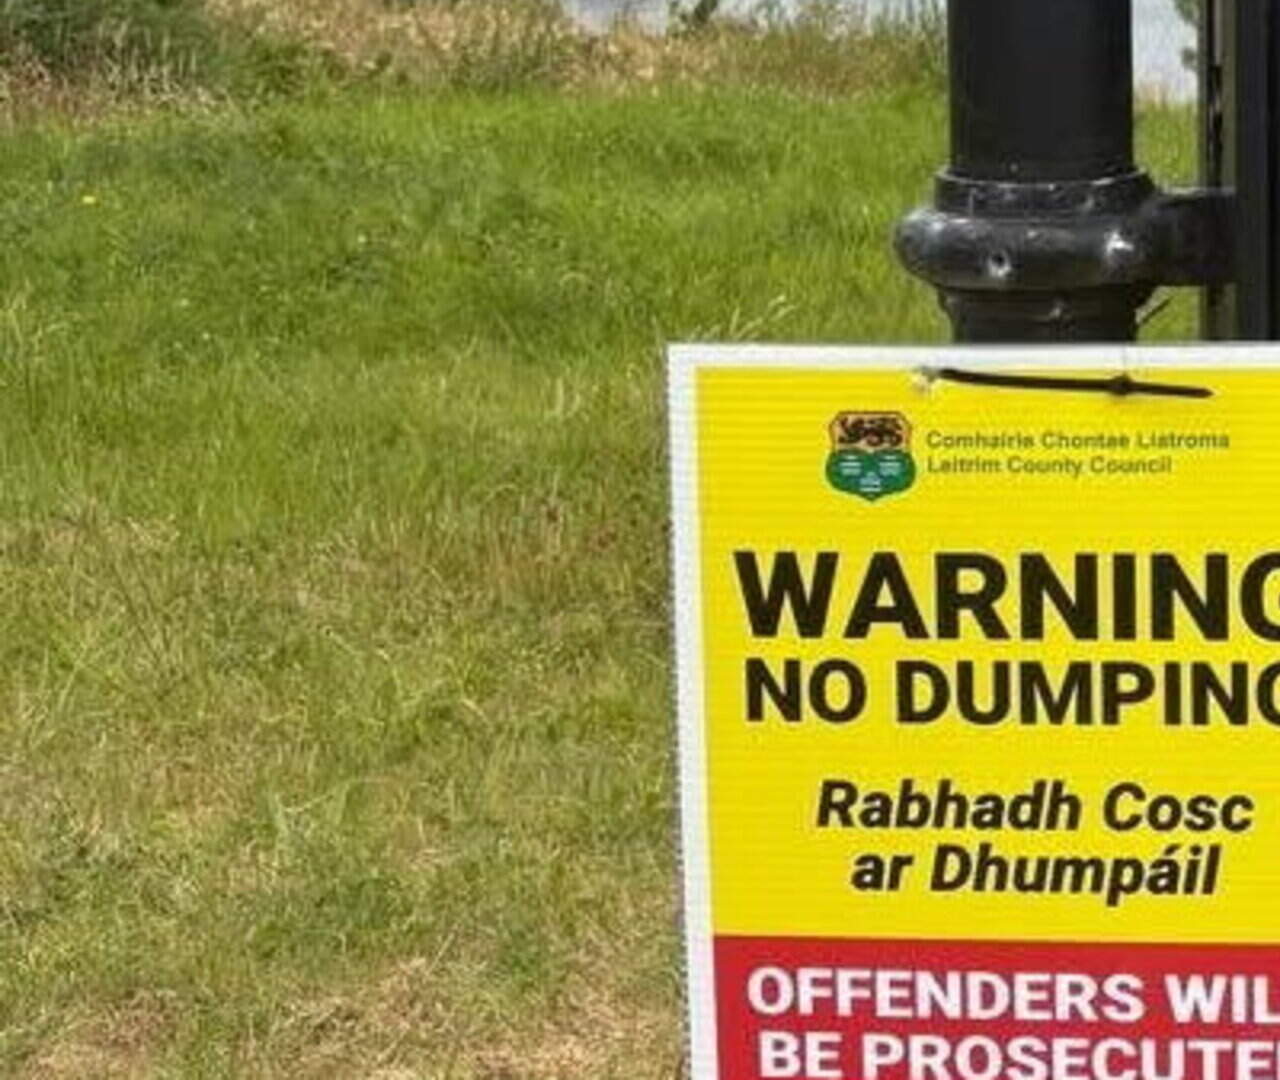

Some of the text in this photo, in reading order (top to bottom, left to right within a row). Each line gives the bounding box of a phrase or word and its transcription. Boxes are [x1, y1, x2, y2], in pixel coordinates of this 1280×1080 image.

[926, 429, 1231, 451] Comhairle Chontae Liatroma
[926, 455, 1173, 478] Leitrim County Council
[744, 656, 867, 724] NO
[817, 778, 1254, 833] Rabhadh Cosc
[850, 841, 1221, 907] ar Dhumpáil
[746, 965, 1145, 1023] OFFENDERS
[758, 1030, 843, 1079] BE
